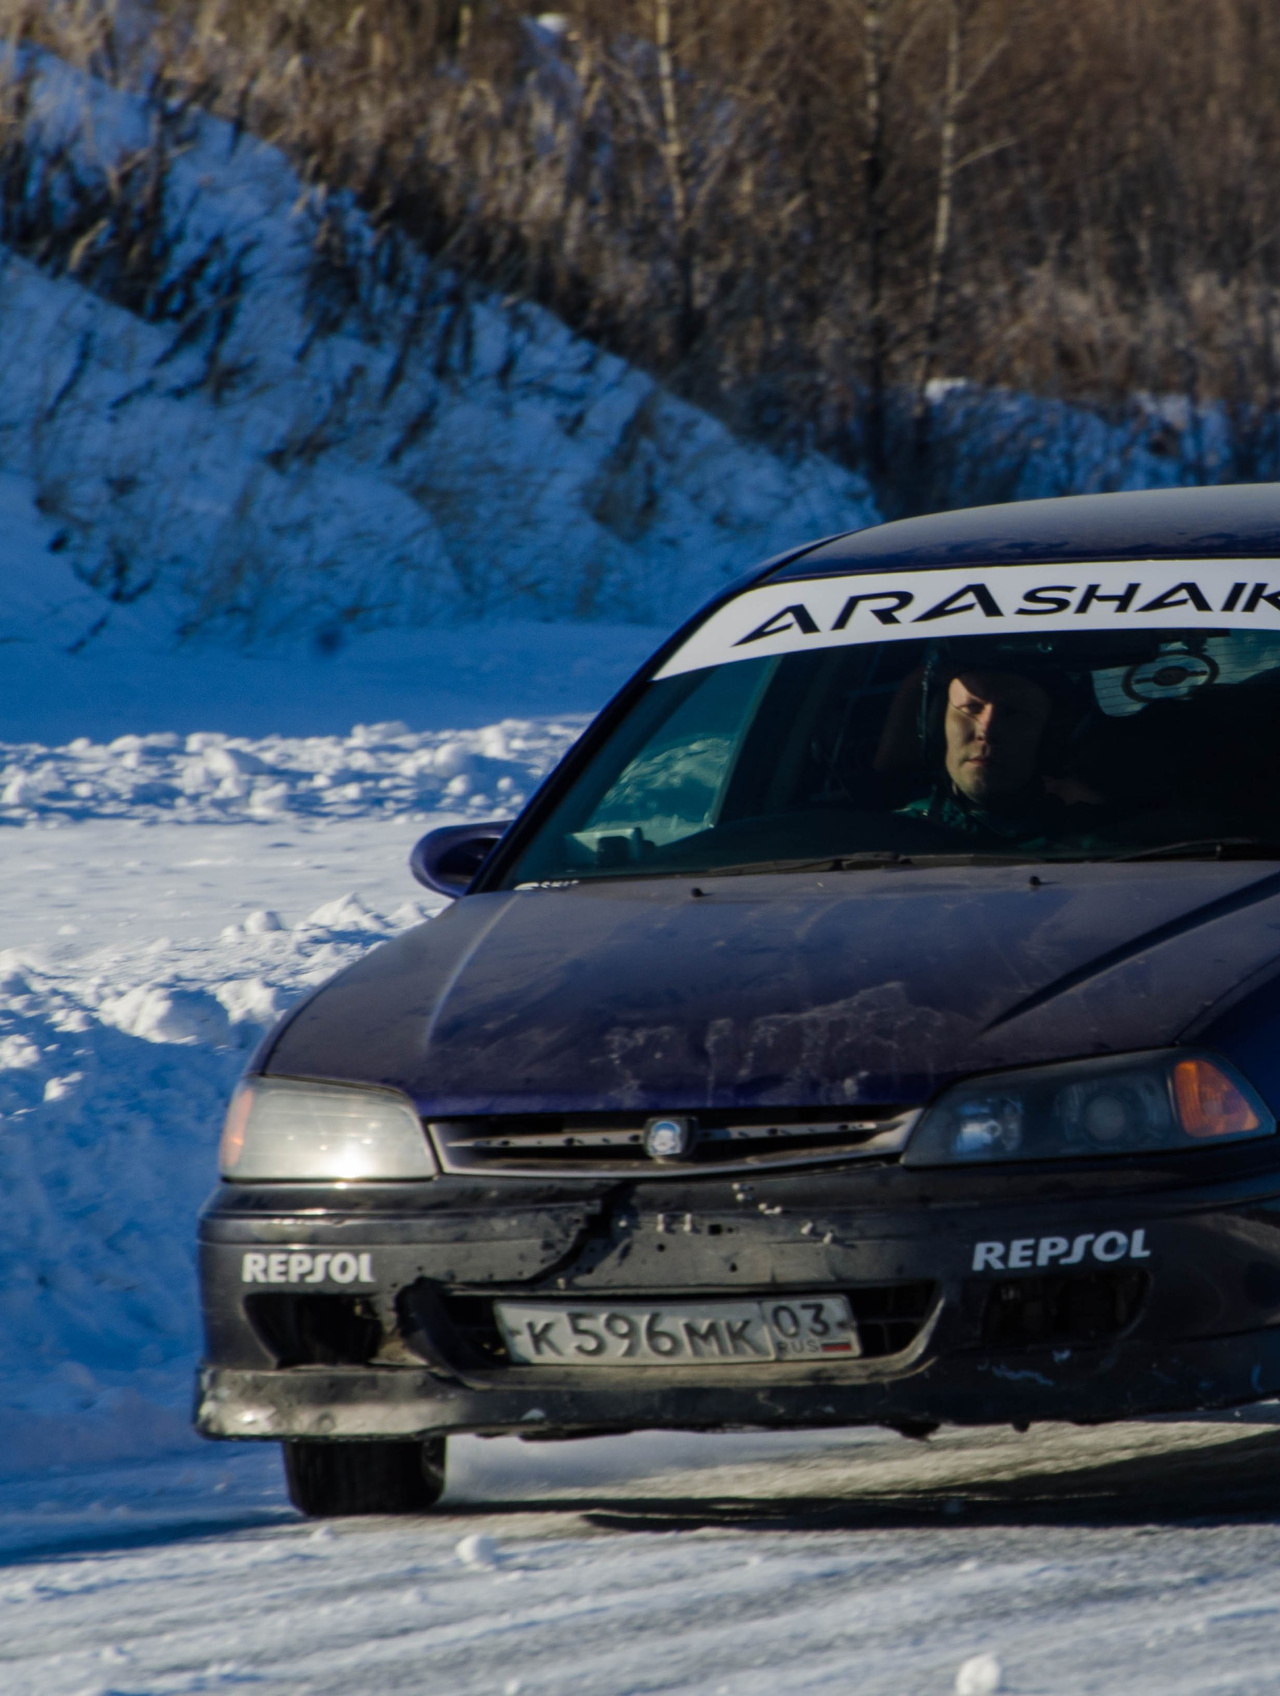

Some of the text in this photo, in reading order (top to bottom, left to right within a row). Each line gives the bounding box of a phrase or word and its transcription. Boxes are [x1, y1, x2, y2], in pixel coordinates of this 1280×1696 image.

[242, 1252, 375, 1283] REPSOL
[972, 1229, 1151, 1271] REPSOL
[772, 1302, 830, 1338] 03
